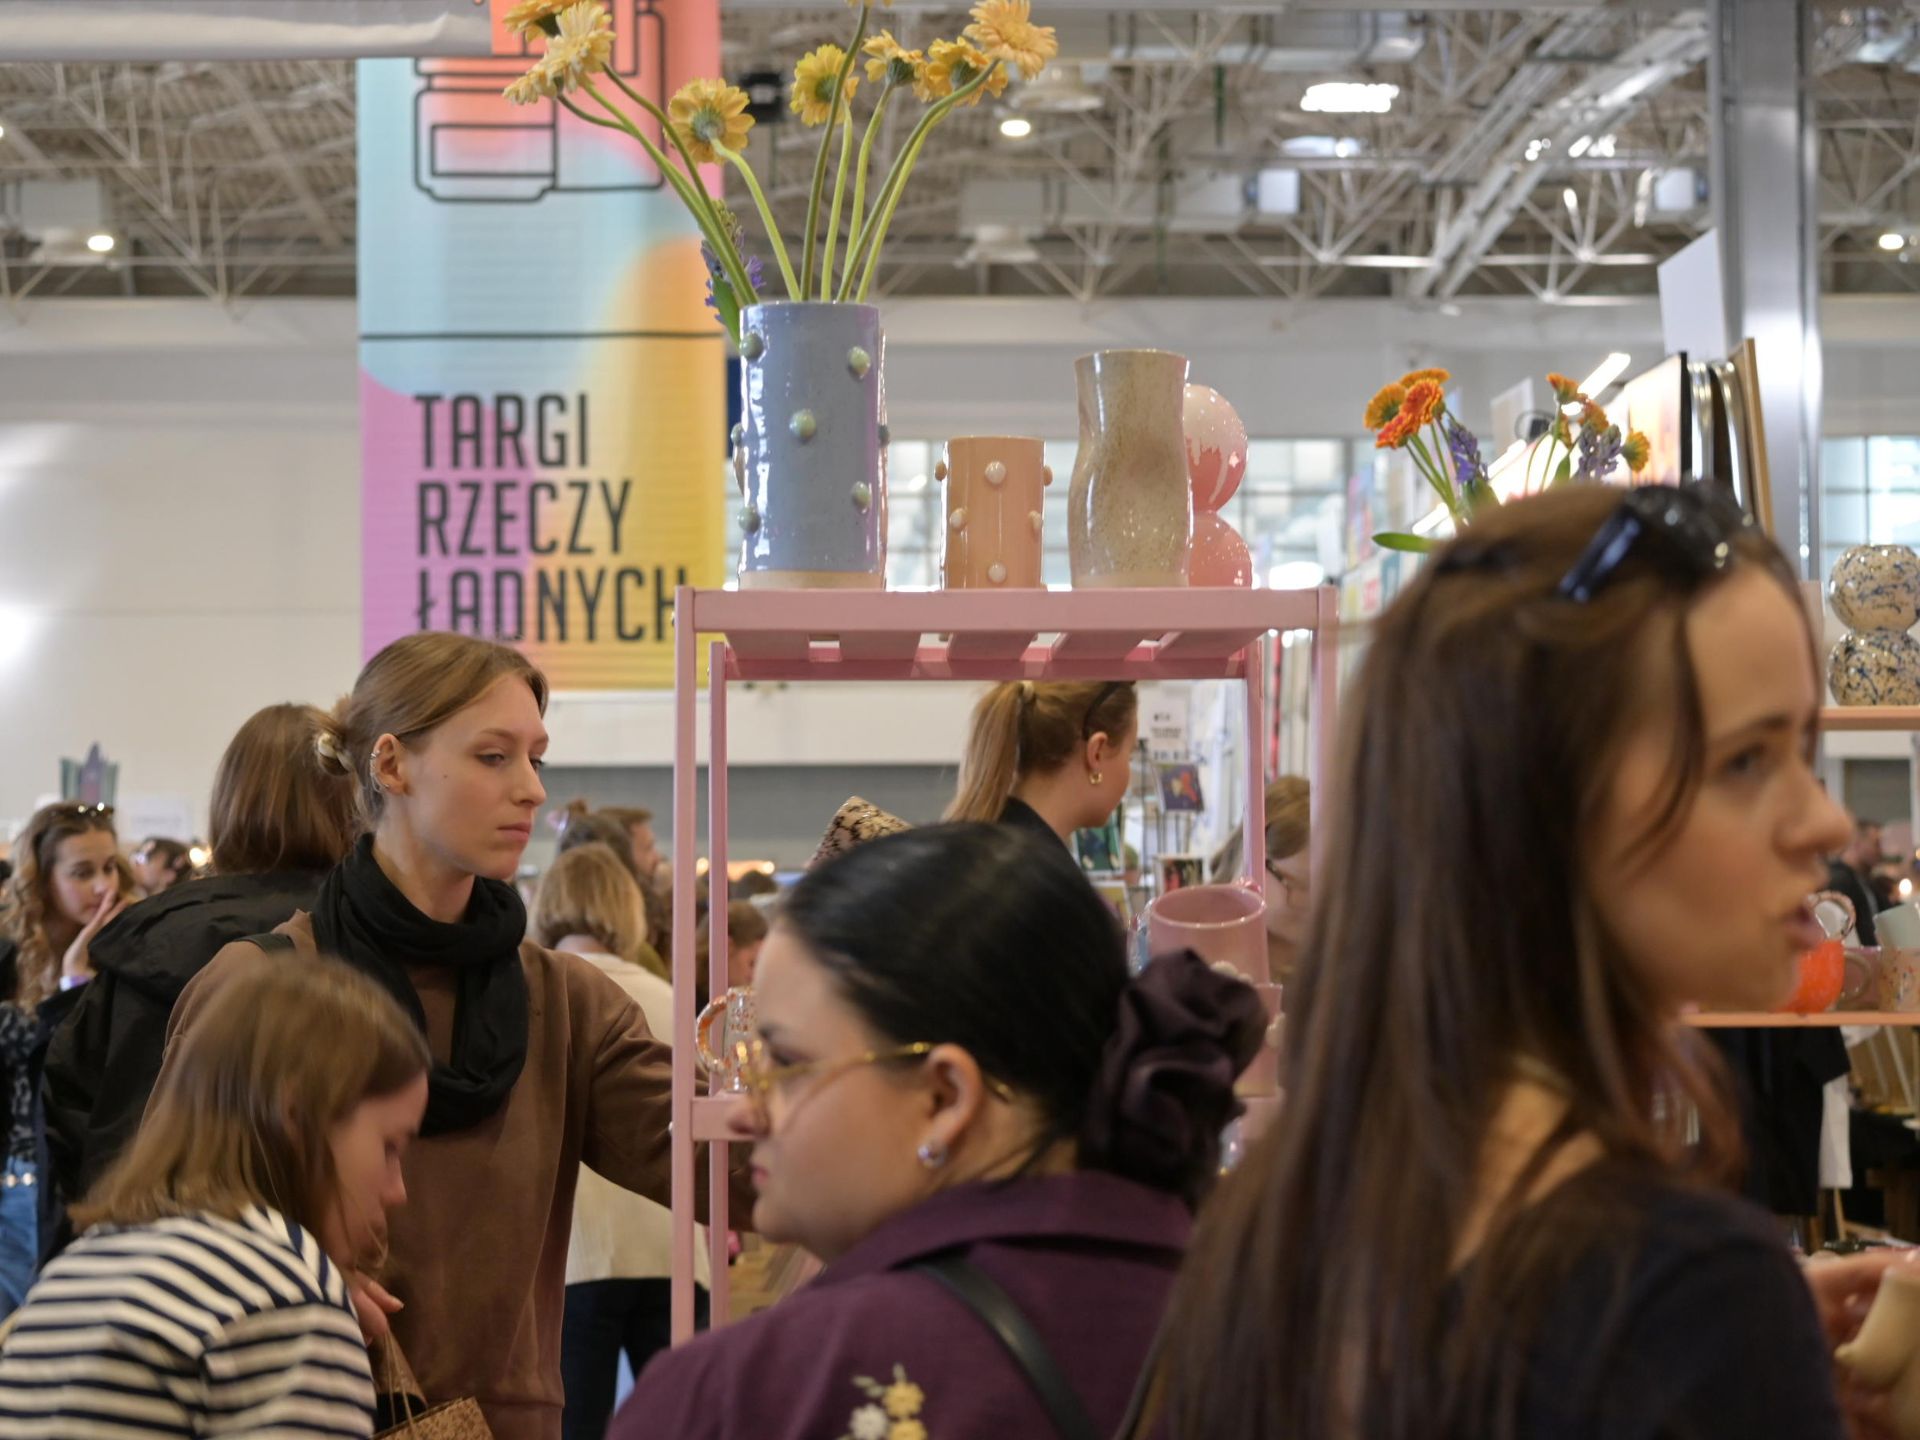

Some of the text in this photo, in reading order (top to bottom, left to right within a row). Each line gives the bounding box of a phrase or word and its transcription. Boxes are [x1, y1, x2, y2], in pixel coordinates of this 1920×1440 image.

[414, 393, 588, 469] TARGI
[417, 479, 633, 557] RZECZY
[414, 567, 686, 643] ŁADNYCH
